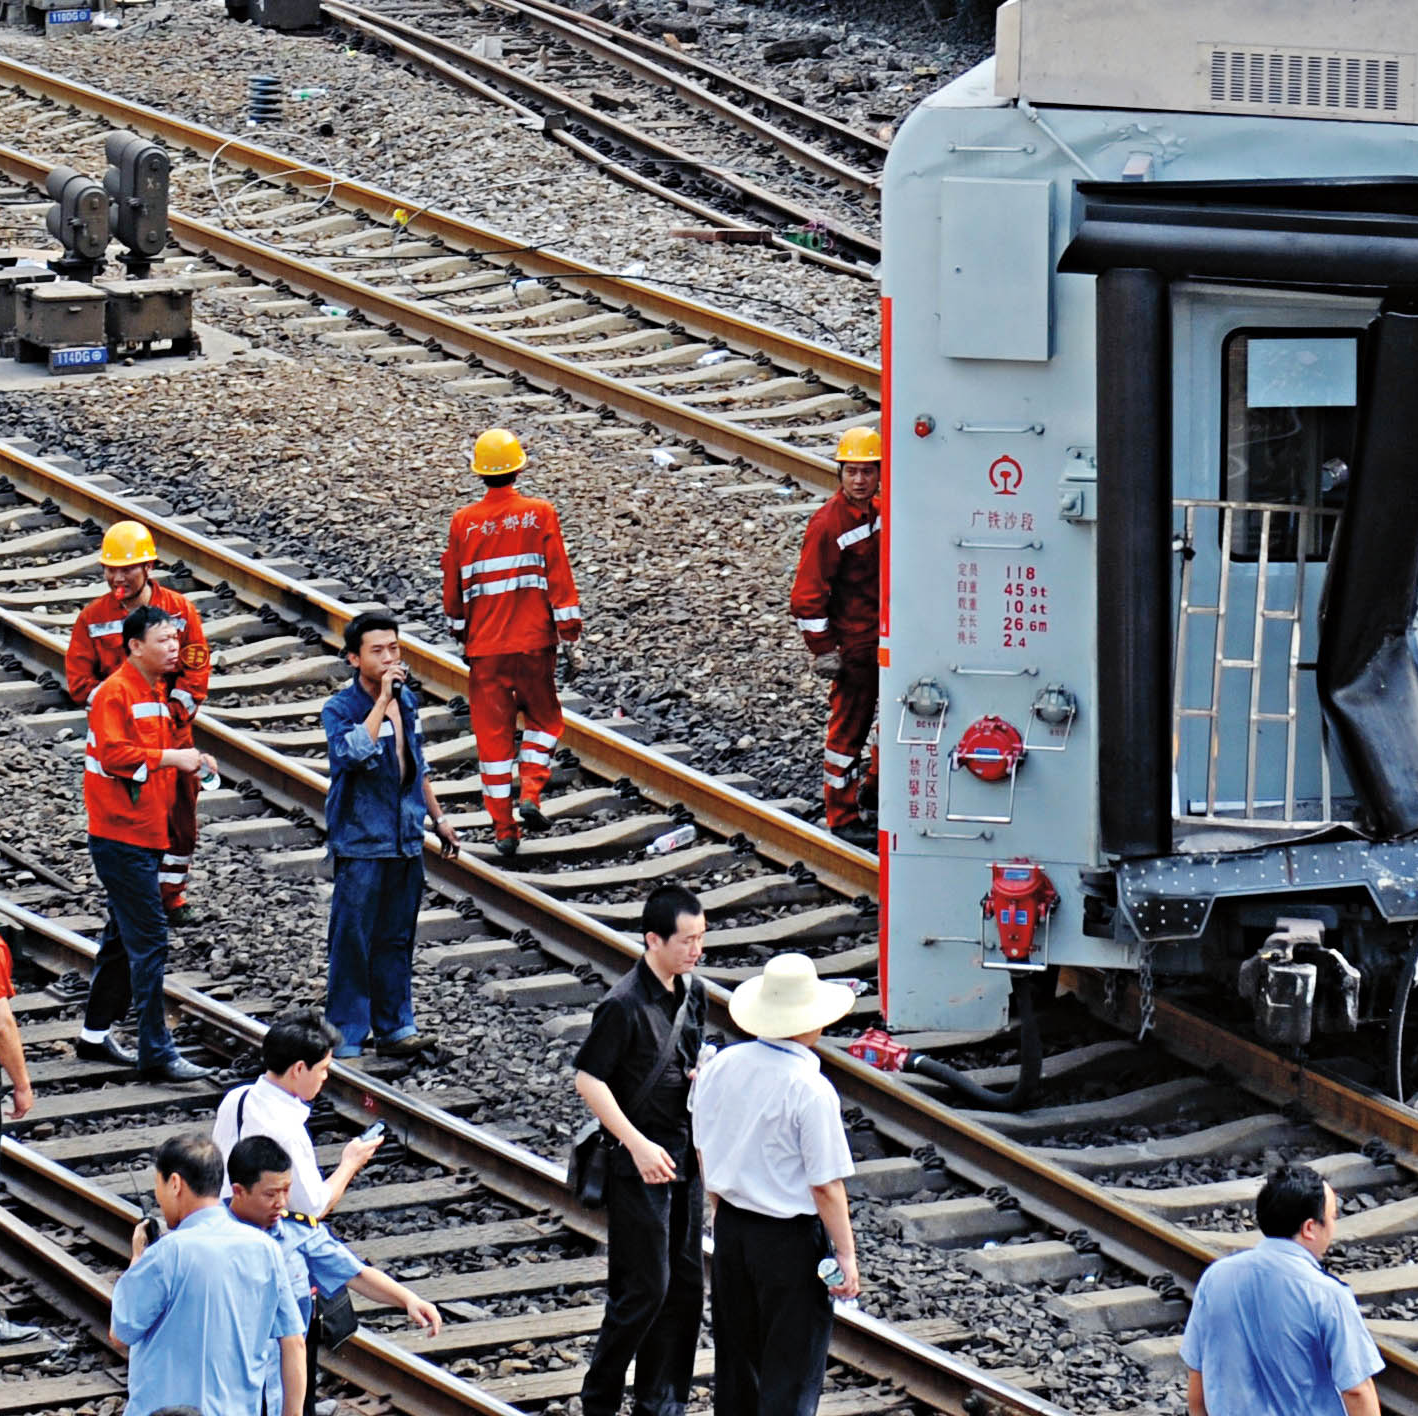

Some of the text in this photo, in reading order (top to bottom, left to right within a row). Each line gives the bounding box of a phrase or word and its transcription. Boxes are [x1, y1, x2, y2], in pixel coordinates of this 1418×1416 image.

[58, 351, 90, 364] 114DG
[971, 510, 1034, 532] 广铁沙段
[957, 580, 978, 594] 自重
[1003, 633, 1026, 648] 2.4
